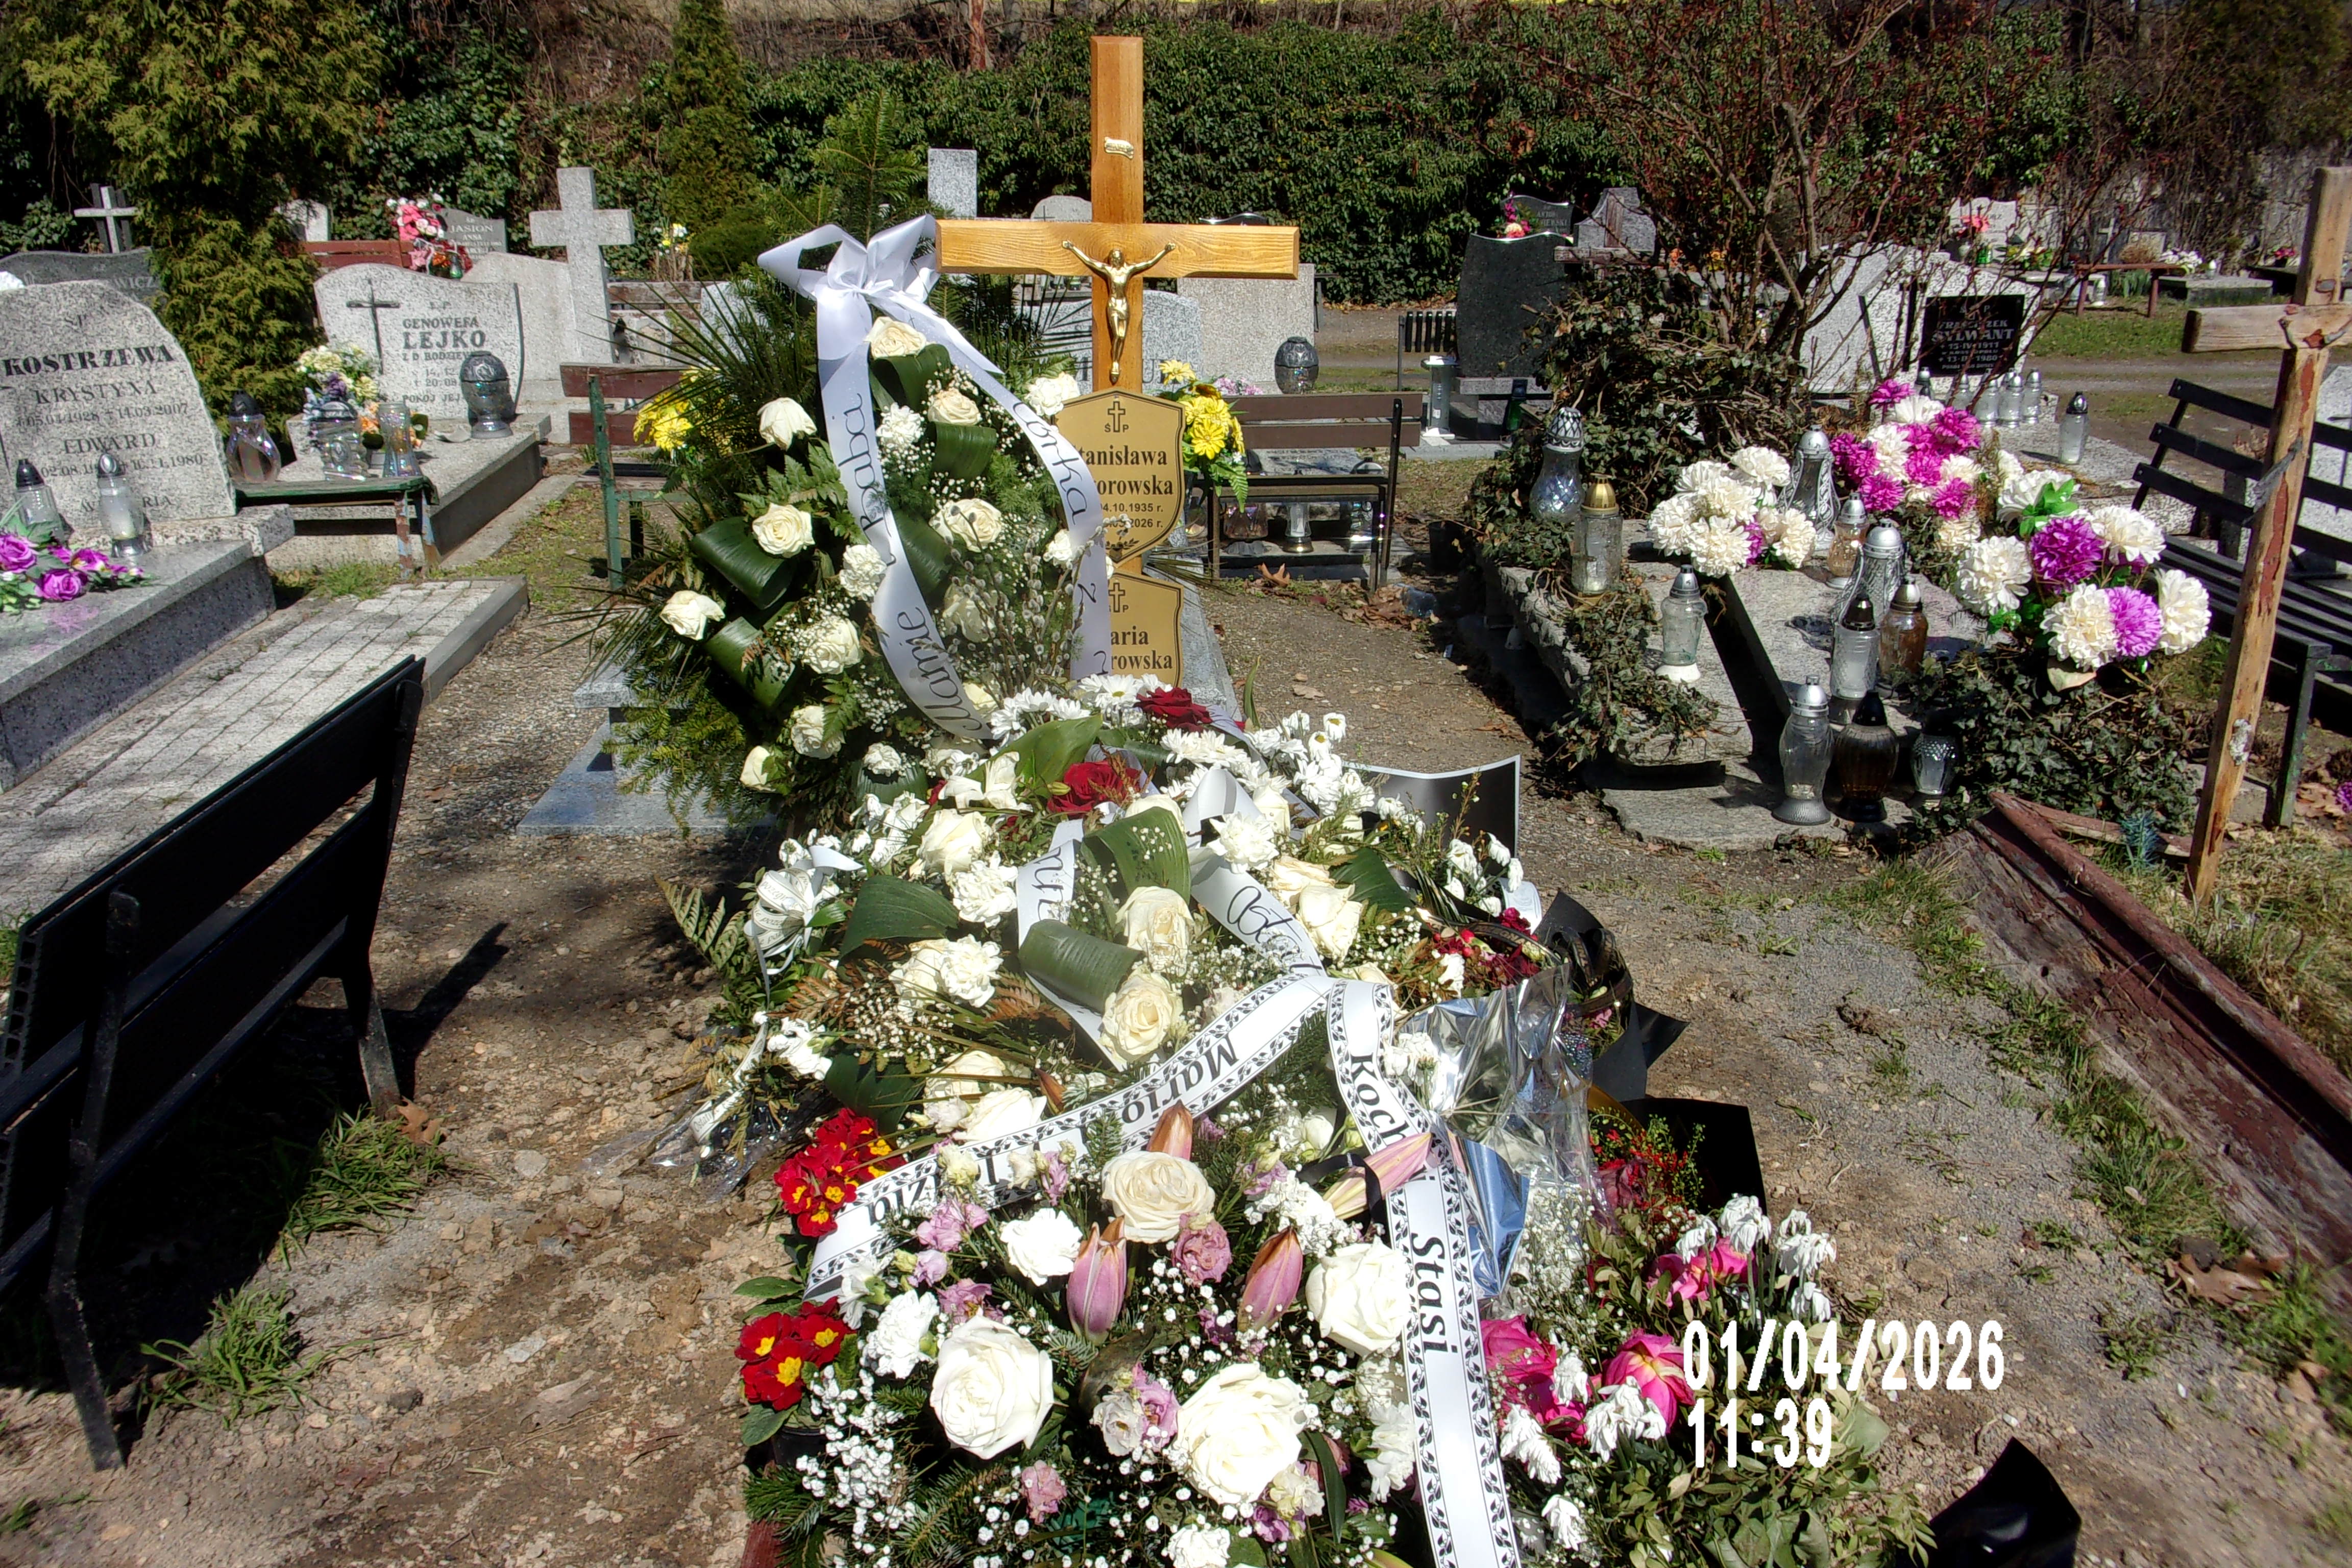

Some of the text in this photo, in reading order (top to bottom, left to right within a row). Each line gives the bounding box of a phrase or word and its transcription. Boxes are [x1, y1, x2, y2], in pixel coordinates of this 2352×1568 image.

[449, 225, 493, 233] JASION
[402, 316, 479, 329] GENOWEFA
[403, 330, 486, 350] LEJKO
[2, 344, 175, 376] KOSTRZEWA
[34, 380, 157, 404] KRYSTYNA
[64, 433, 156, 455] EDWARD
[1074, 445, 1167, 466] tanisława
[1093, 474, 1173, 496] orowska
[1100, 503, 1154, 512] 4.10.1935
[1110, 625, 1149, 645] aria
[1111, 649, 1173, 670] rowska
[1411, 1232, 1458, 1354] Stasi
